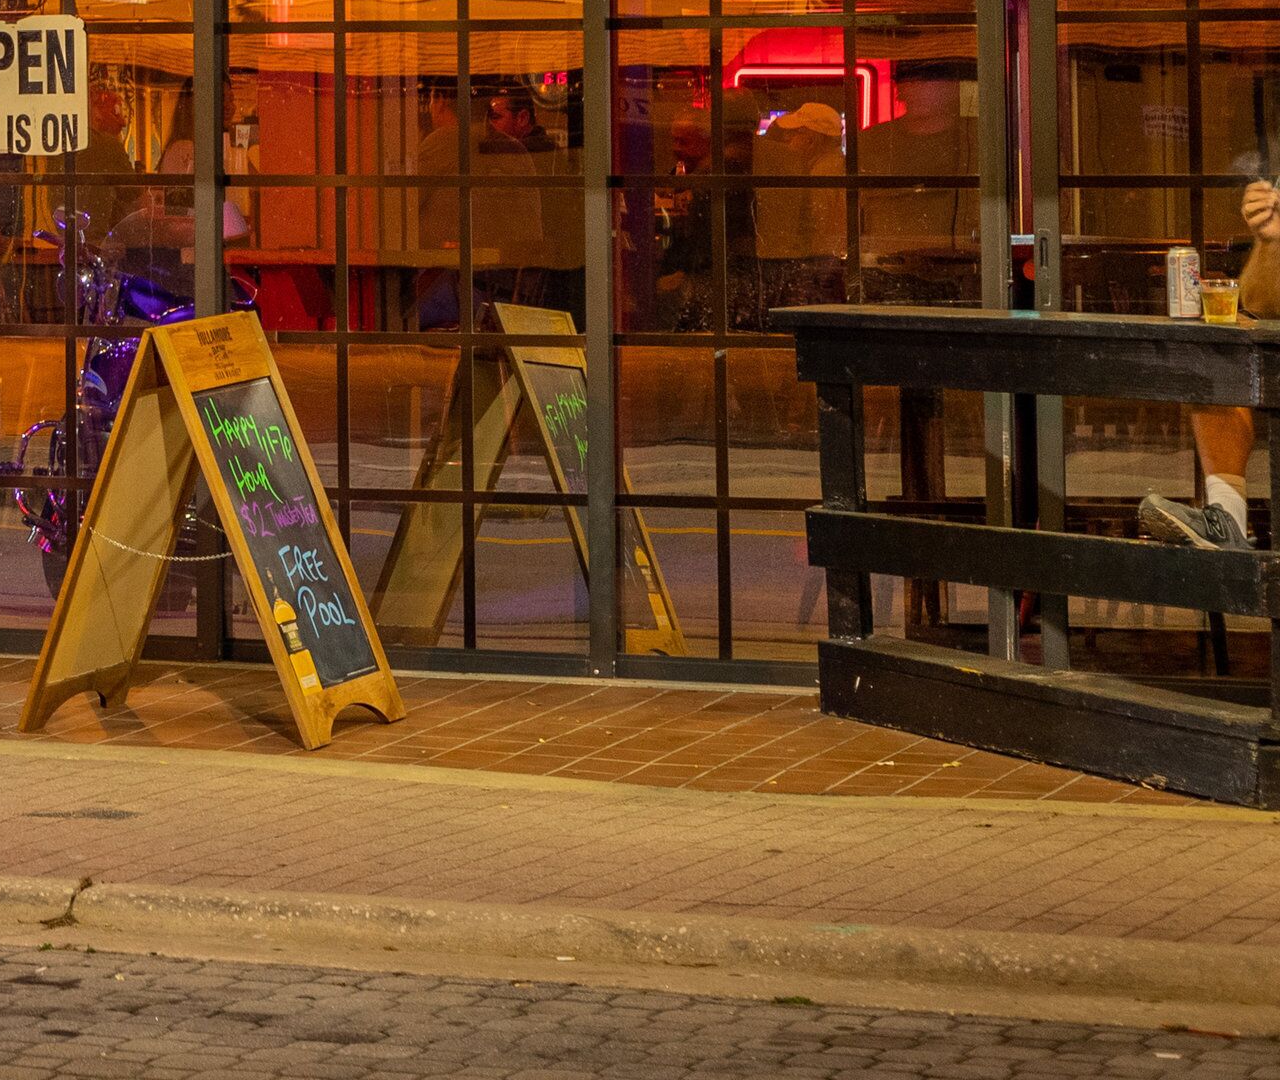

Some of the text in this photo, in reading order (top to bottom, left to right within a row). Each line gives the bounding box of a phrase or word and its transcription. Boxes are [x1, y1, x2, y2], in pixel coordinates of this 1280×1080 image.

[7, 114, 31, 153] IS
[42, 113, 78, 152] ON
[278, 545, 328, 591] FREE
[297, 585, 356, 639] POOL
